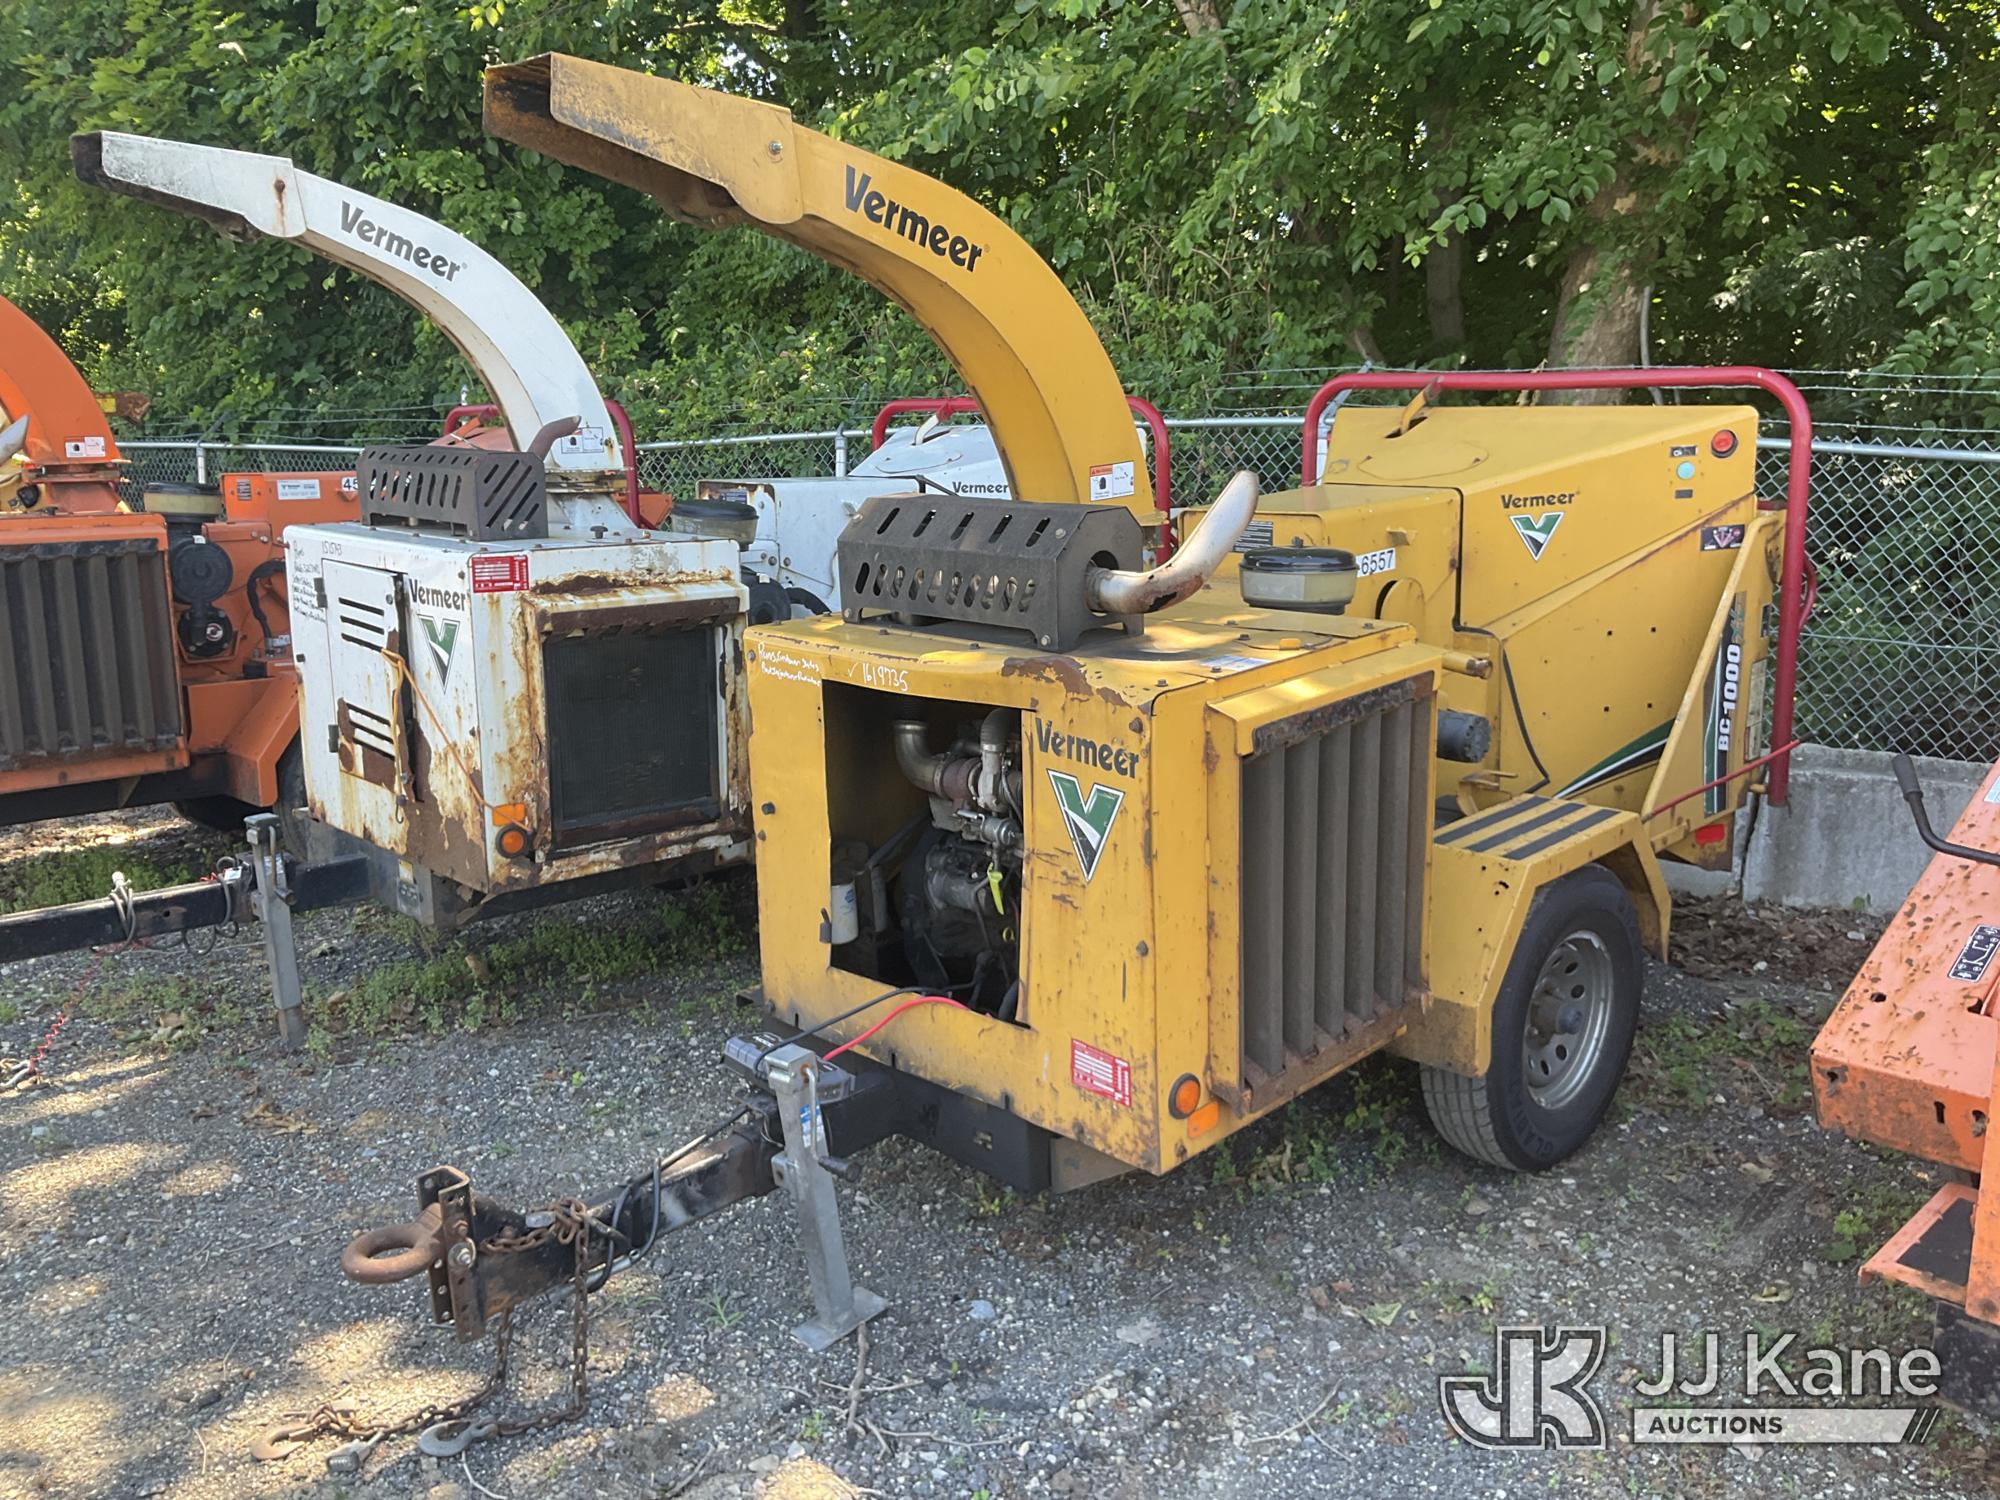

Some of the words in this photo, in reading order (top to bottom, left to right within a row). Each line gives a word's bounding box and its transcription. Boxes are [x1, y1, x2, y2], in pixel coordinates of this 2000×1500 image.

[340, 200, 461, 282] Vermeer
[840, 164, 983, 273] Vermeer
[952, 481, 1008, 494] Vermeer
[1500, 493, 1575, 509] Vermeer
[409, 578, 466, 611] Vermeer
[1035, 717, 1139, 779] Vermeer
